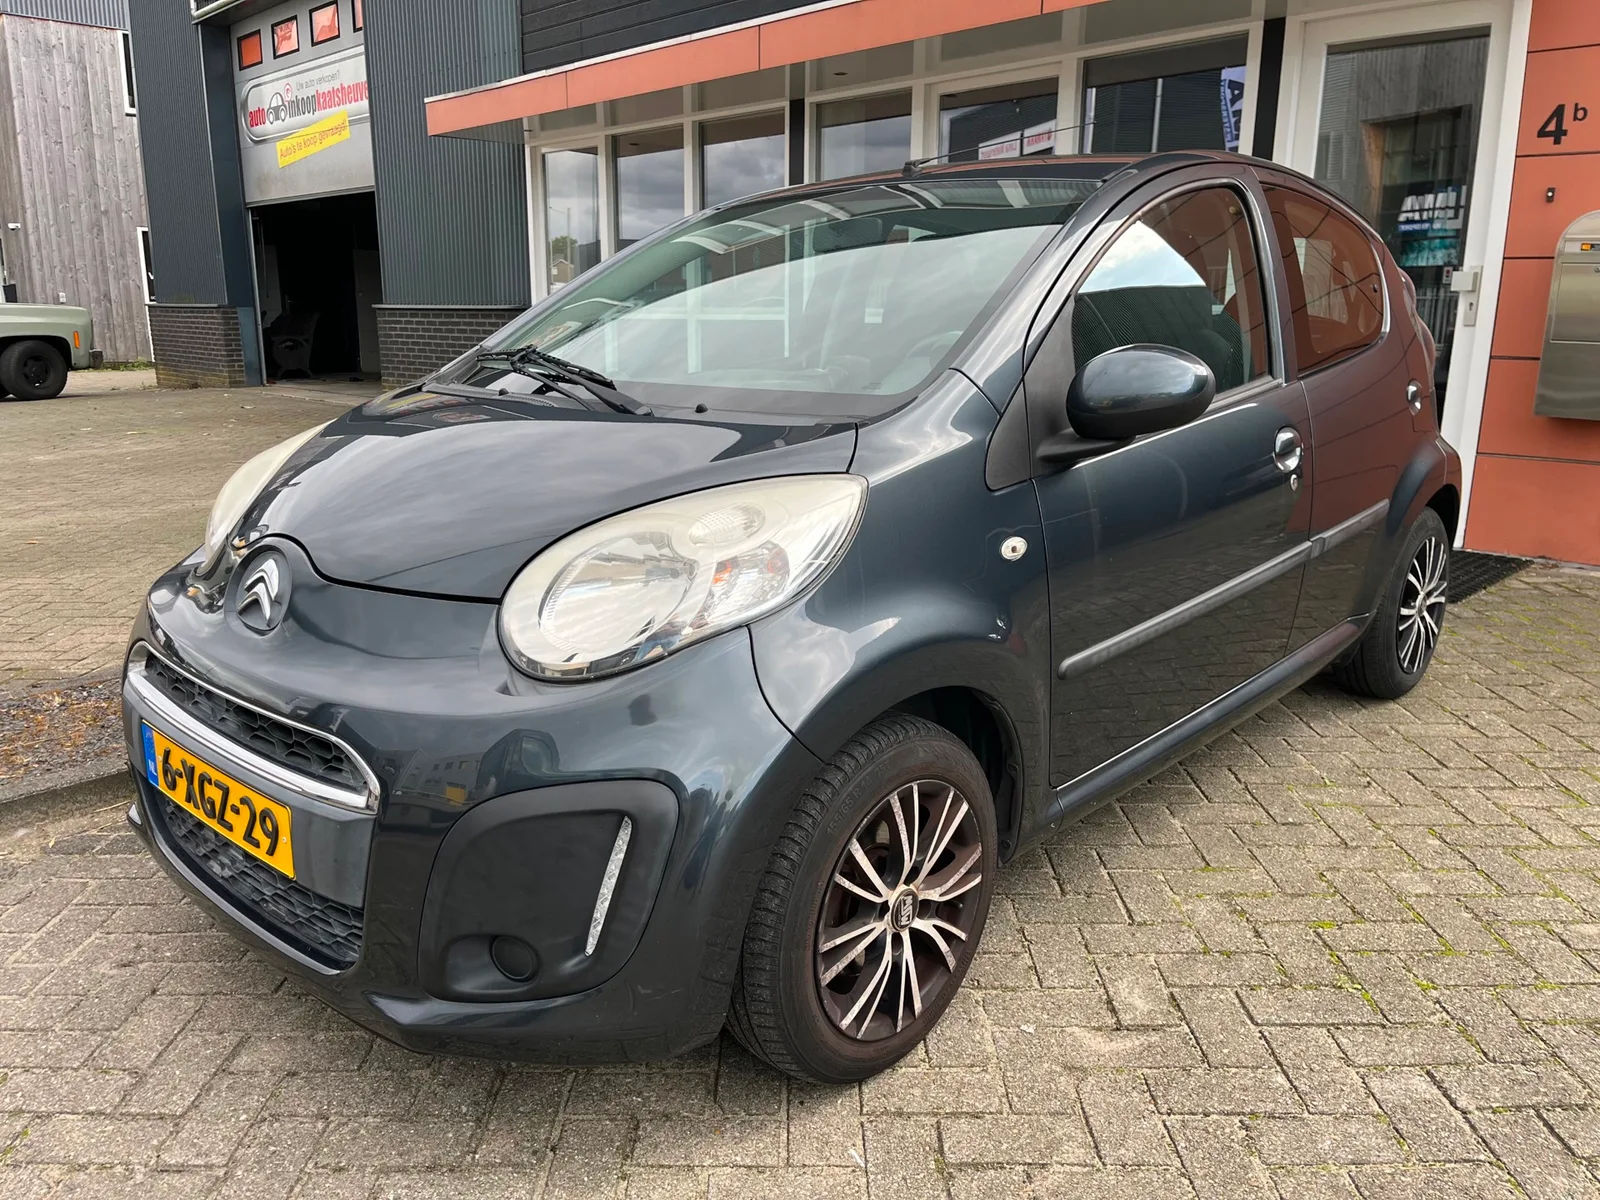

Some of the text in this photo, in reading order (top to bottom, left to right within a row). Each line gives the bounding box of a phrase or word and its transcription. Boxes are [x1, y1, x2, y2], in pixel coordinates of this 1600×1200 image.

[305, 78, 315, 89] auto
[316, 69, 340, 85] verkopen?
[248, 107, 266, 128] auto
[280, 143, 296, 159] Auto's
[303, 134, 317, 148] koop
[319, 118, 348, 144] gevraagd!
[162, 747, 279, 857] 6-XGZ-29
